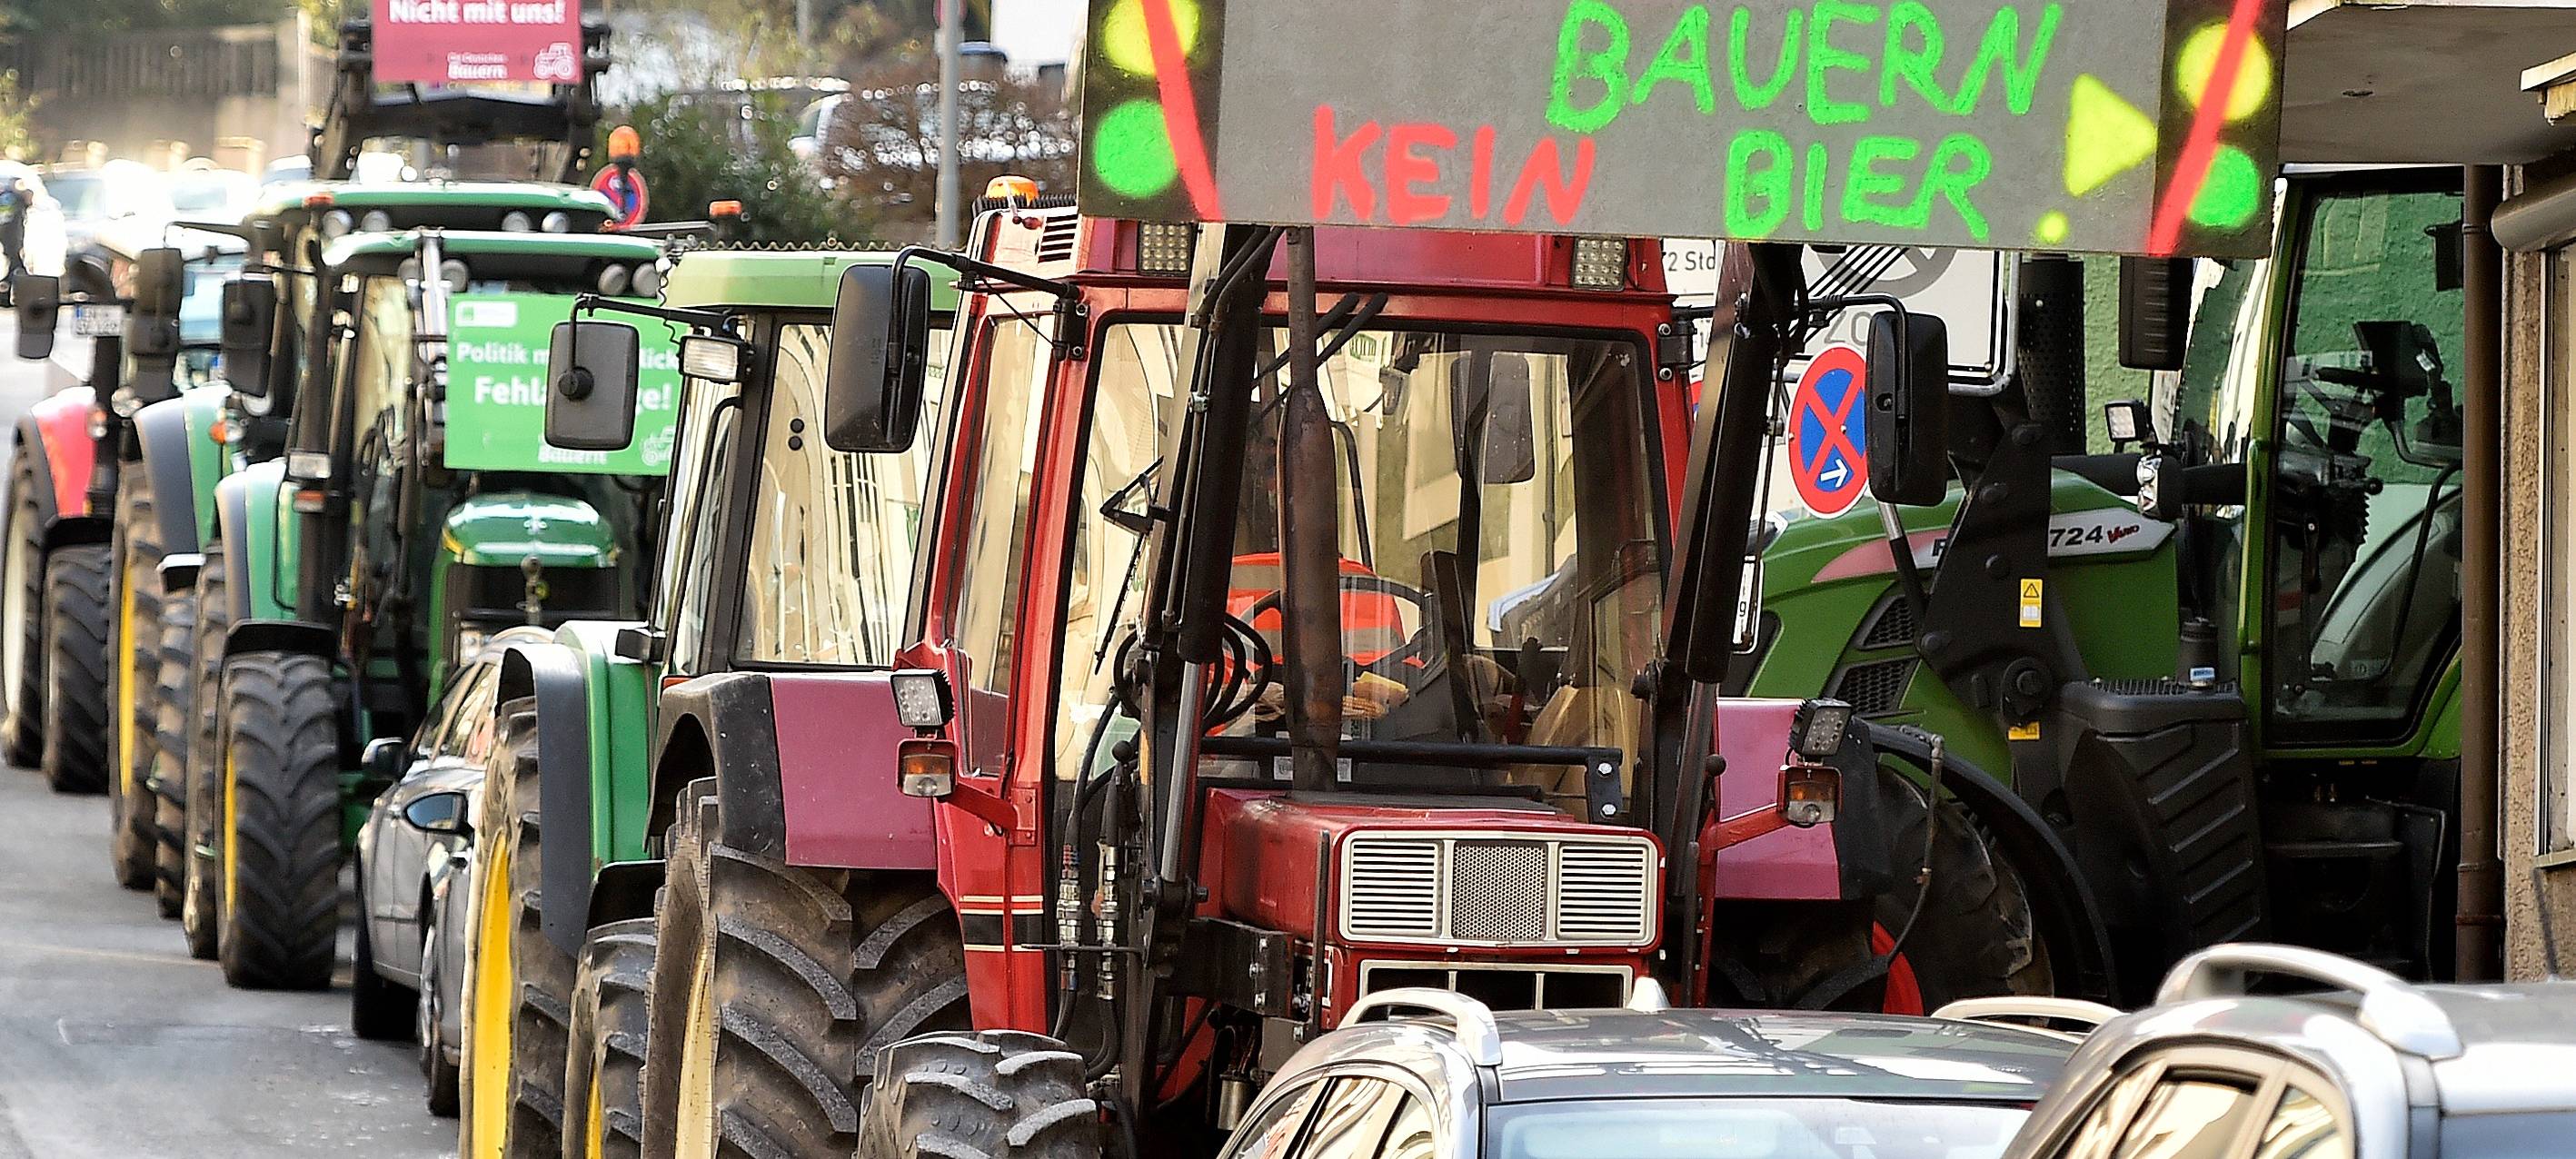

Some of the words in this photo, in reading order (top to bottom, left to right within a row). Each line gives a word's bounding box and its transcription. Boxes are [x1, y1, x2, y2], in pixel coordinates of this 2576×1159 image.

[389, 0, 460, 23] Nicht
[462, 0, 507, 23] mit
[511, 2, 565, 24] uns!
[1546, 0, 2063, 134] BAUERN
[1312, 104, 1596, 226] KEIN
[1726, 129, 1993, 240] BIER
[457, 342, 528, 364] Politik
[2049, 525, 2104, 547] 724
